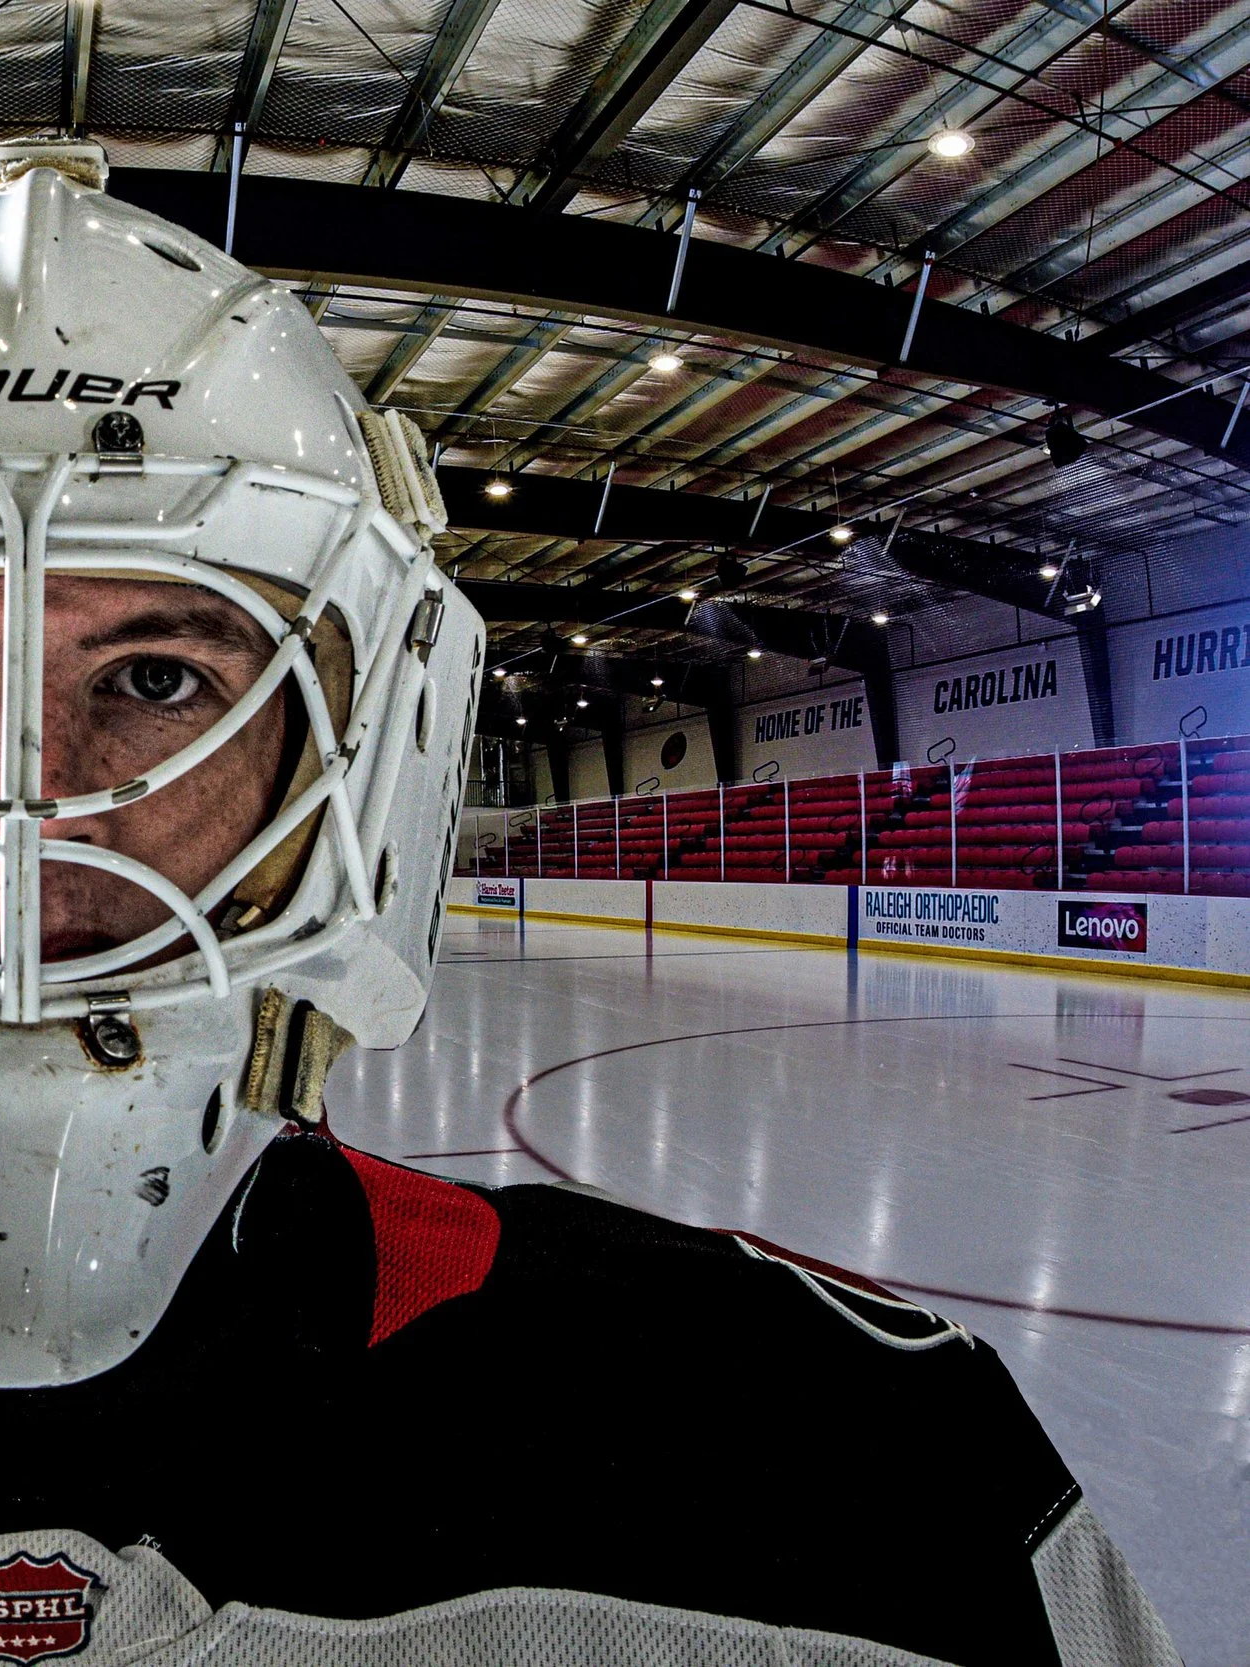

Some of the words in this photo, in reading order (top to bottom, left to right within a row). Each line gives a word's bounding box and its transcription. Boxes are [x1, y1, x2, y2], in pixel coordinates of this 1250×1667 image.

[933, 660, 1058, 714] CAROLINA
[754, 708, 802, 744] HOME
[804, 704, 826, 735] OF
[830, 696, 864, 731] THE
[866, 891, 911, 919] RALEIGH
[915, 893, 999, 924] ORTHOPAEDIC
[876, 921, 912, 936] OFFICIAL
[915, 924, 939, 938] TEAM
[942, 926, 985, 942] DOCTORS
[1065, 911, 1139, 939] Lenovo
